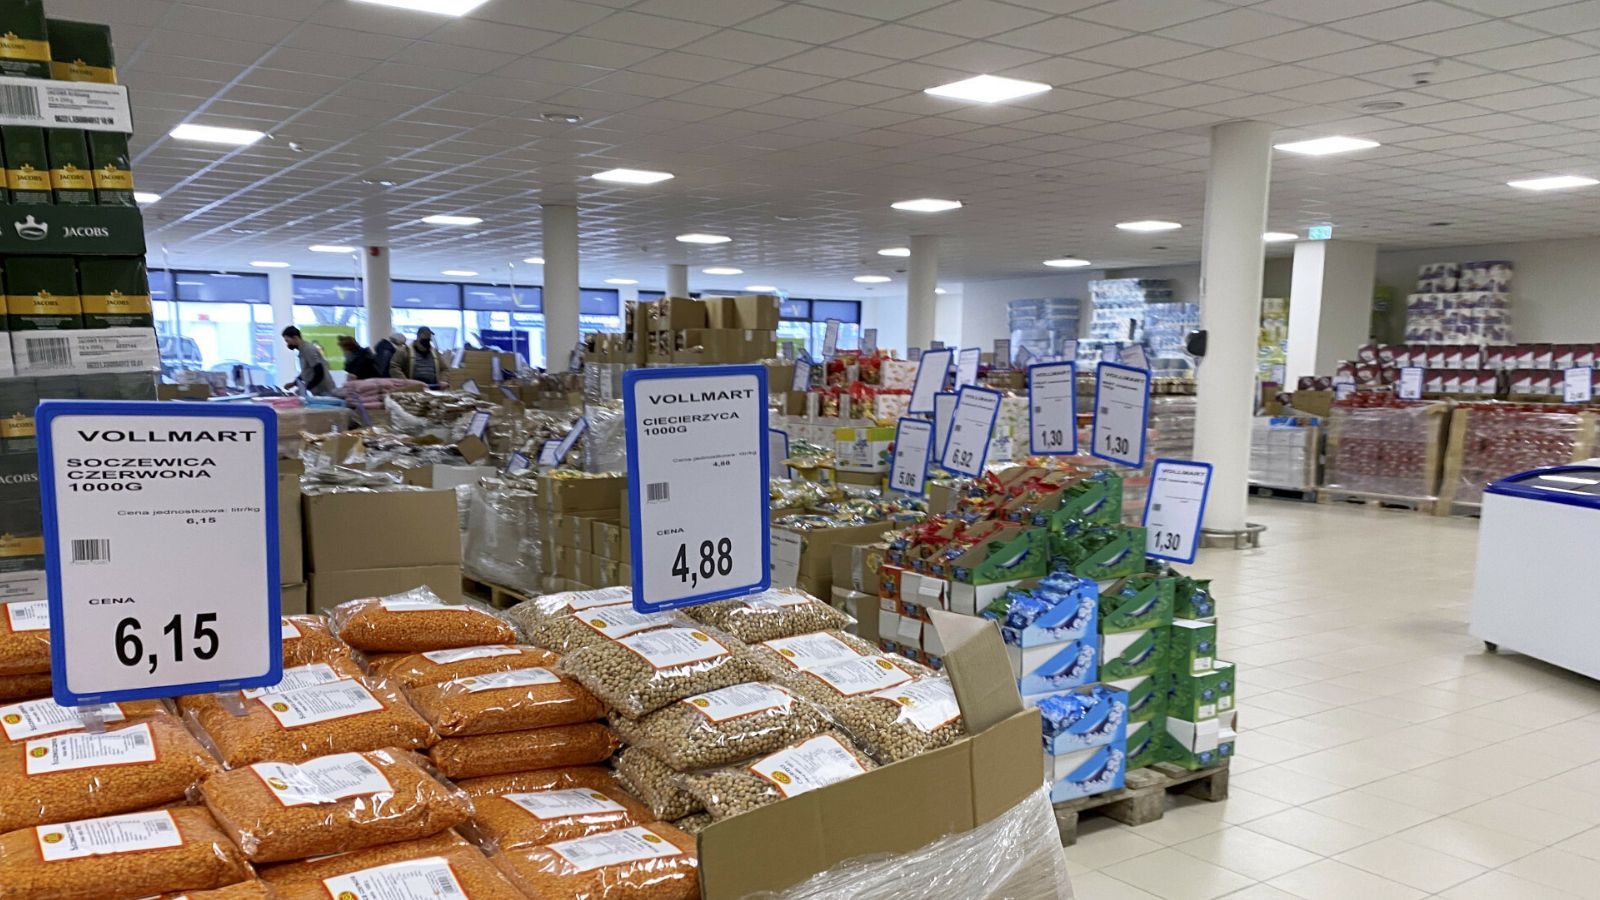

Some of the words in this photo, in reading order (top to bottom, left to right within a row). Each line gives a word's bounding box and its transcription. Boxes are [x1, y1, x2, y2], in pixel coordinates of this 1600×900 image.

[63, 226, 109, 238] JACOBS
[648, 389, 754, 405] VOLLMART
[643, 411, 740, 426] CIECIERZYCA
[77, 430, 257, 442] VOLLMART
[644, 426, 688, 436] 1000G
[1041, 430, 1063, 449] 1,30
[1105, 434, 1129, 455] 1,30
[66, 458, 216, 468] SOCZEWICA
[67, 469, 211, 479] CZERWONA
[68, 482, 143, 492] 1000G
[186, 517, 216, 525] 6,15
[656, 527, 685, 536] CENA
[1154, 530, 1180, 552] 1,30
[672, 537, 733, 589] 4,88
[89, 597, 136, 605] CENA
[115, 612, 219, 675] 6,15
